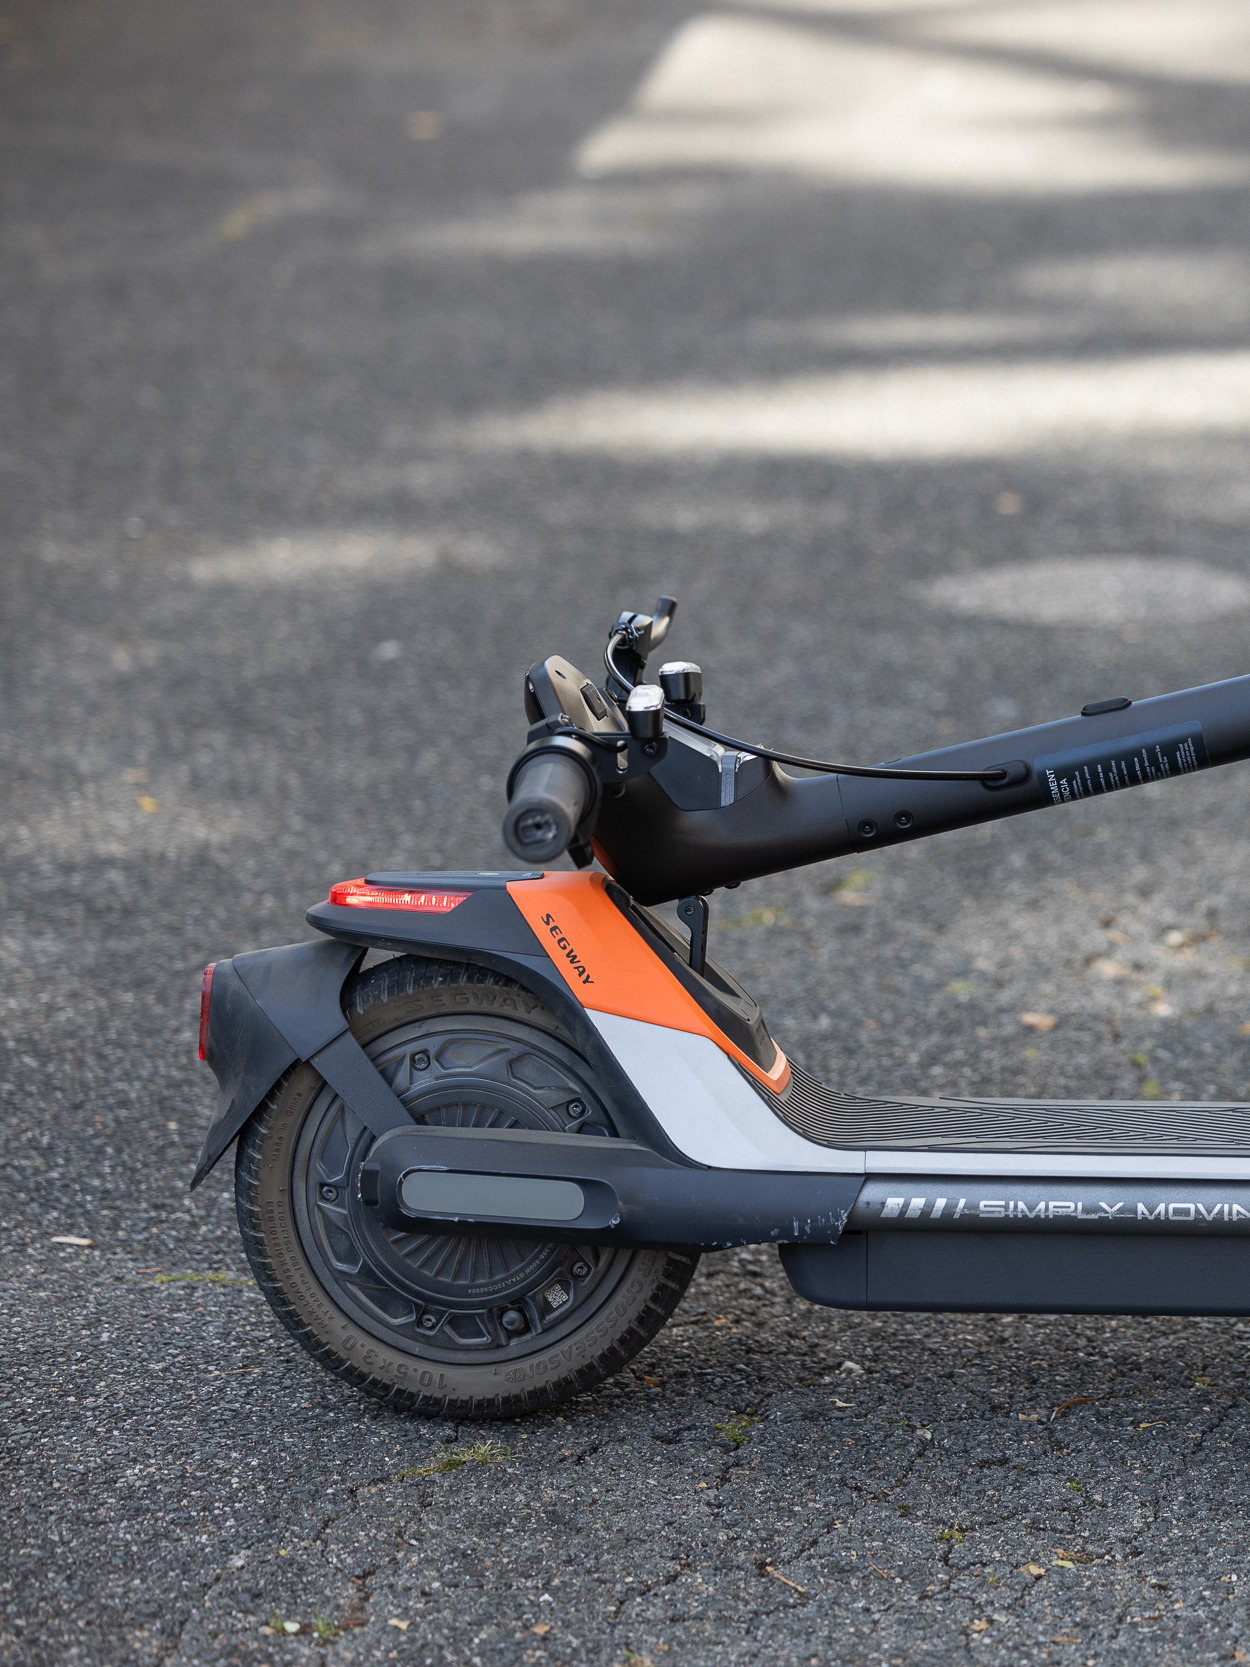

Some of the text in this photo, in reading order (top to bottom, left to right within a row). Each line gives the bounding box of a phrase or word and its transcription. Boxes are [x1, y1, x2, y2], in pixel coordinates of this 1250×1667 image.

[541, 913, 594, 984] SEGWAY
[402, 991, 540, 1017] SEGWAY
[283, 1089, 303, 1117] China
[278, 1121, 289, 1131] in
[271, 1135, 284, 1161] Made
[979, 1201, 1124, 1220] SIMPLY
